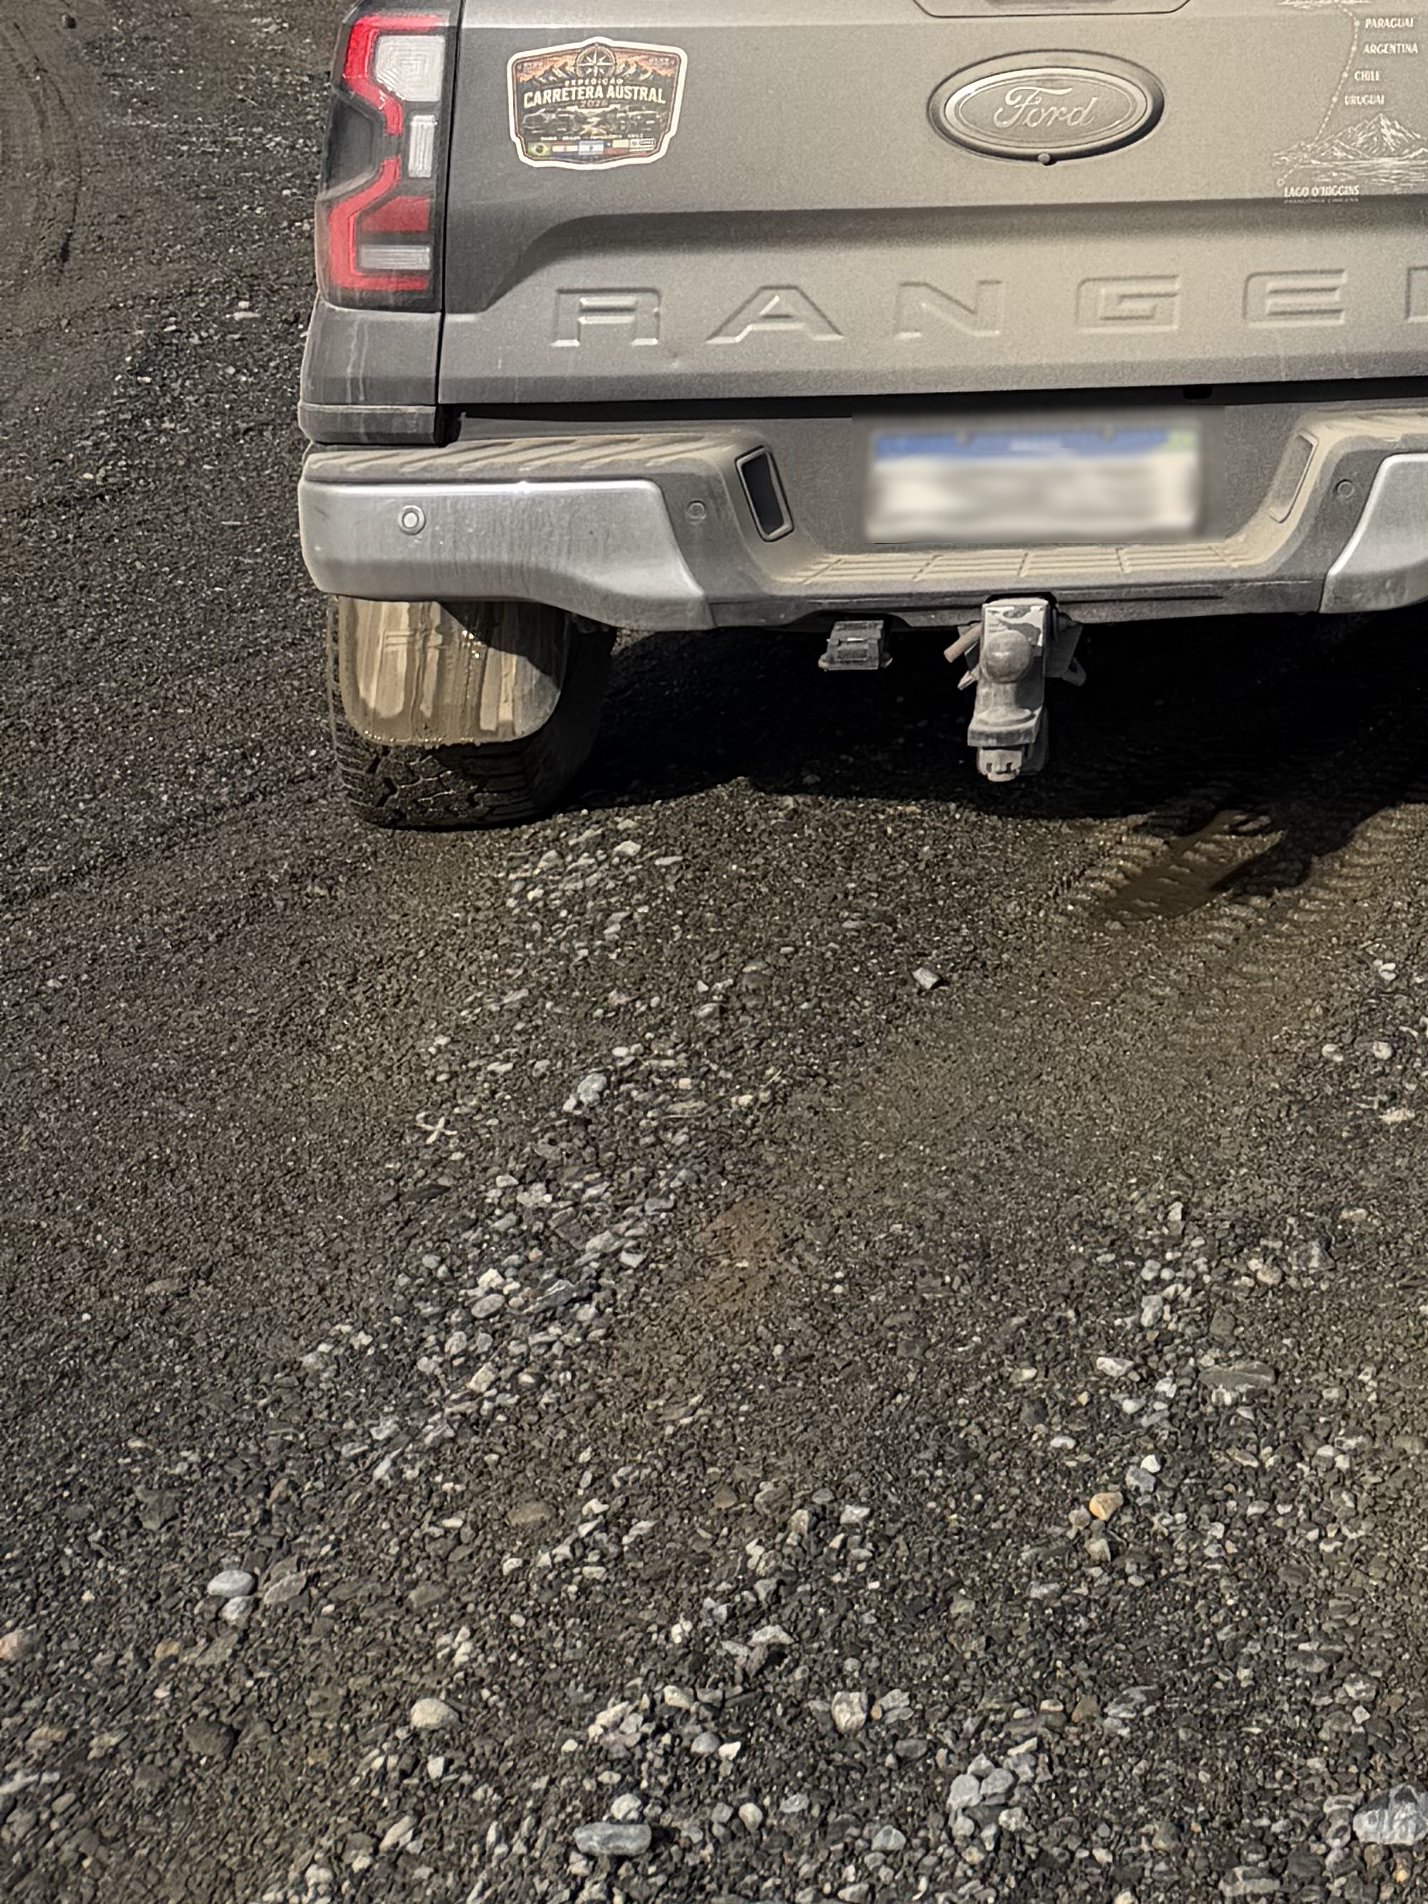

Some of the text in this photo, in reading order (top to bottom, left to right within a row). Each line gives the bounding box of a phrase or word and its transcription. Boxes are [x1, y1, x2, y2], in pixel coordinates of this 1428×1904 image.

[1363, 42, 1419, 55] ARGENTINA
[523, 85, 667, 109] CARRETERA AUSTRAL
[993, 86, 1098, 128] Ford
[1284, 186, 1309, 198] LAGO
